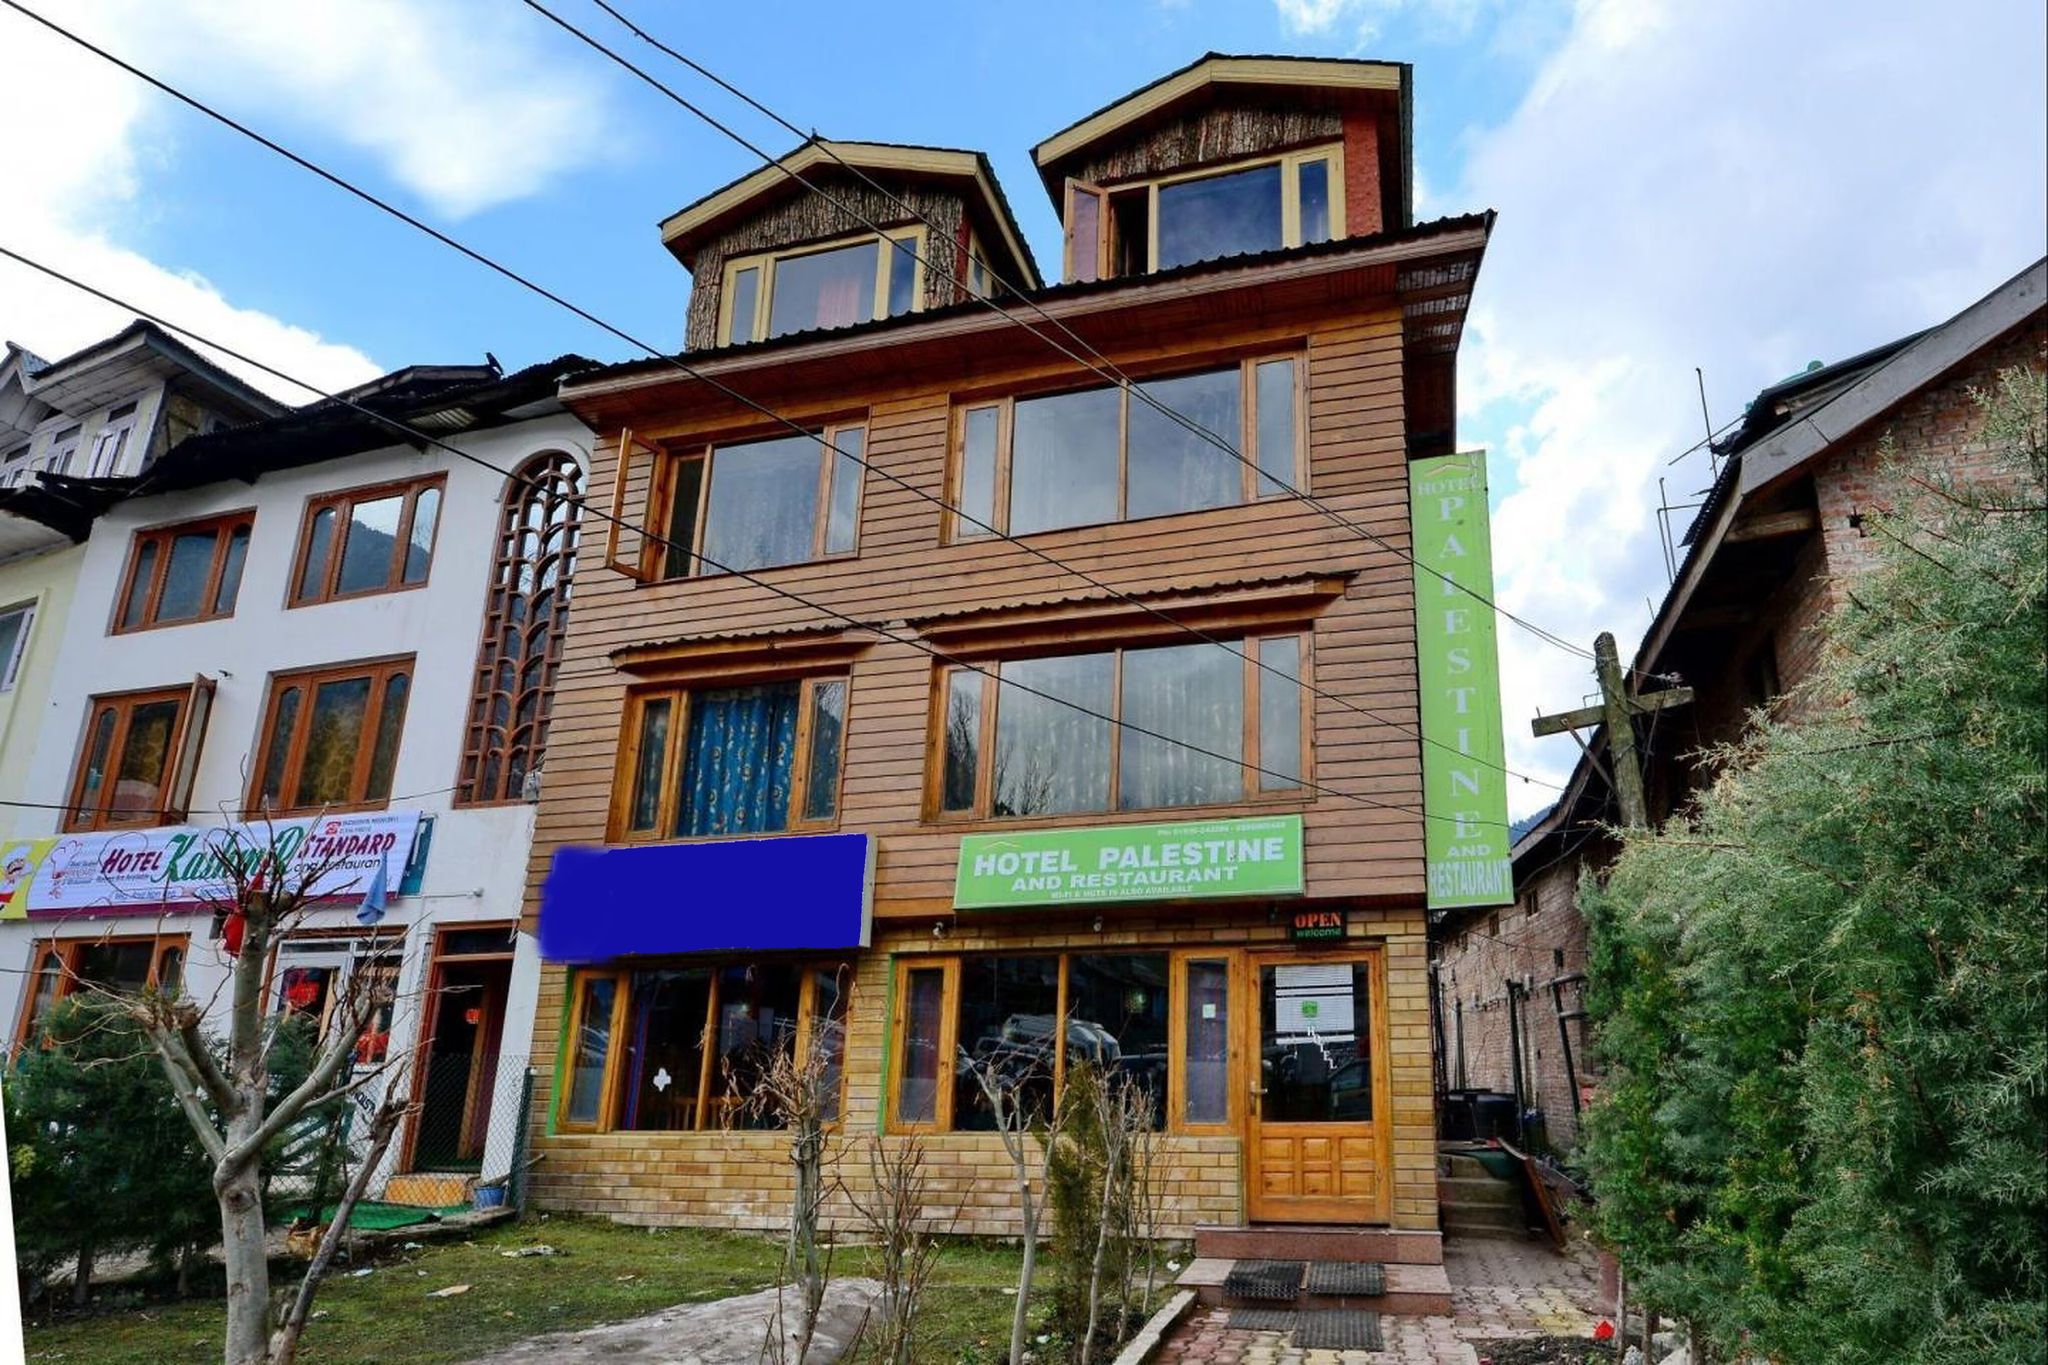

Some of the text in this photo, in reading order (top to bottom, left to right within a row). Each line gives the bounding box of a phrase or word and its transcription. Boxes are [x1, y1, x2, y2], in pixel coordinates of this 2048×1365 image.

[1417, 476, 1479, 496] HOTEL
[1440, 496, 1482, 840] PALESTINE
[100, 848, 162, 874] HOTEL
[298, 832, 396, 858] STANDARD
[973, 836, 1285, 877] HOTEL PALESTINE
[1448, 843, 1491, 857] AND
[1011, 865, 1239, 893] AND RESTAURANT
[1428, 860, 1511, 898] RESTAURANT
[1295, 911, 1341, 928] OPEN
[1296, 928, 1341, 938] welcome
